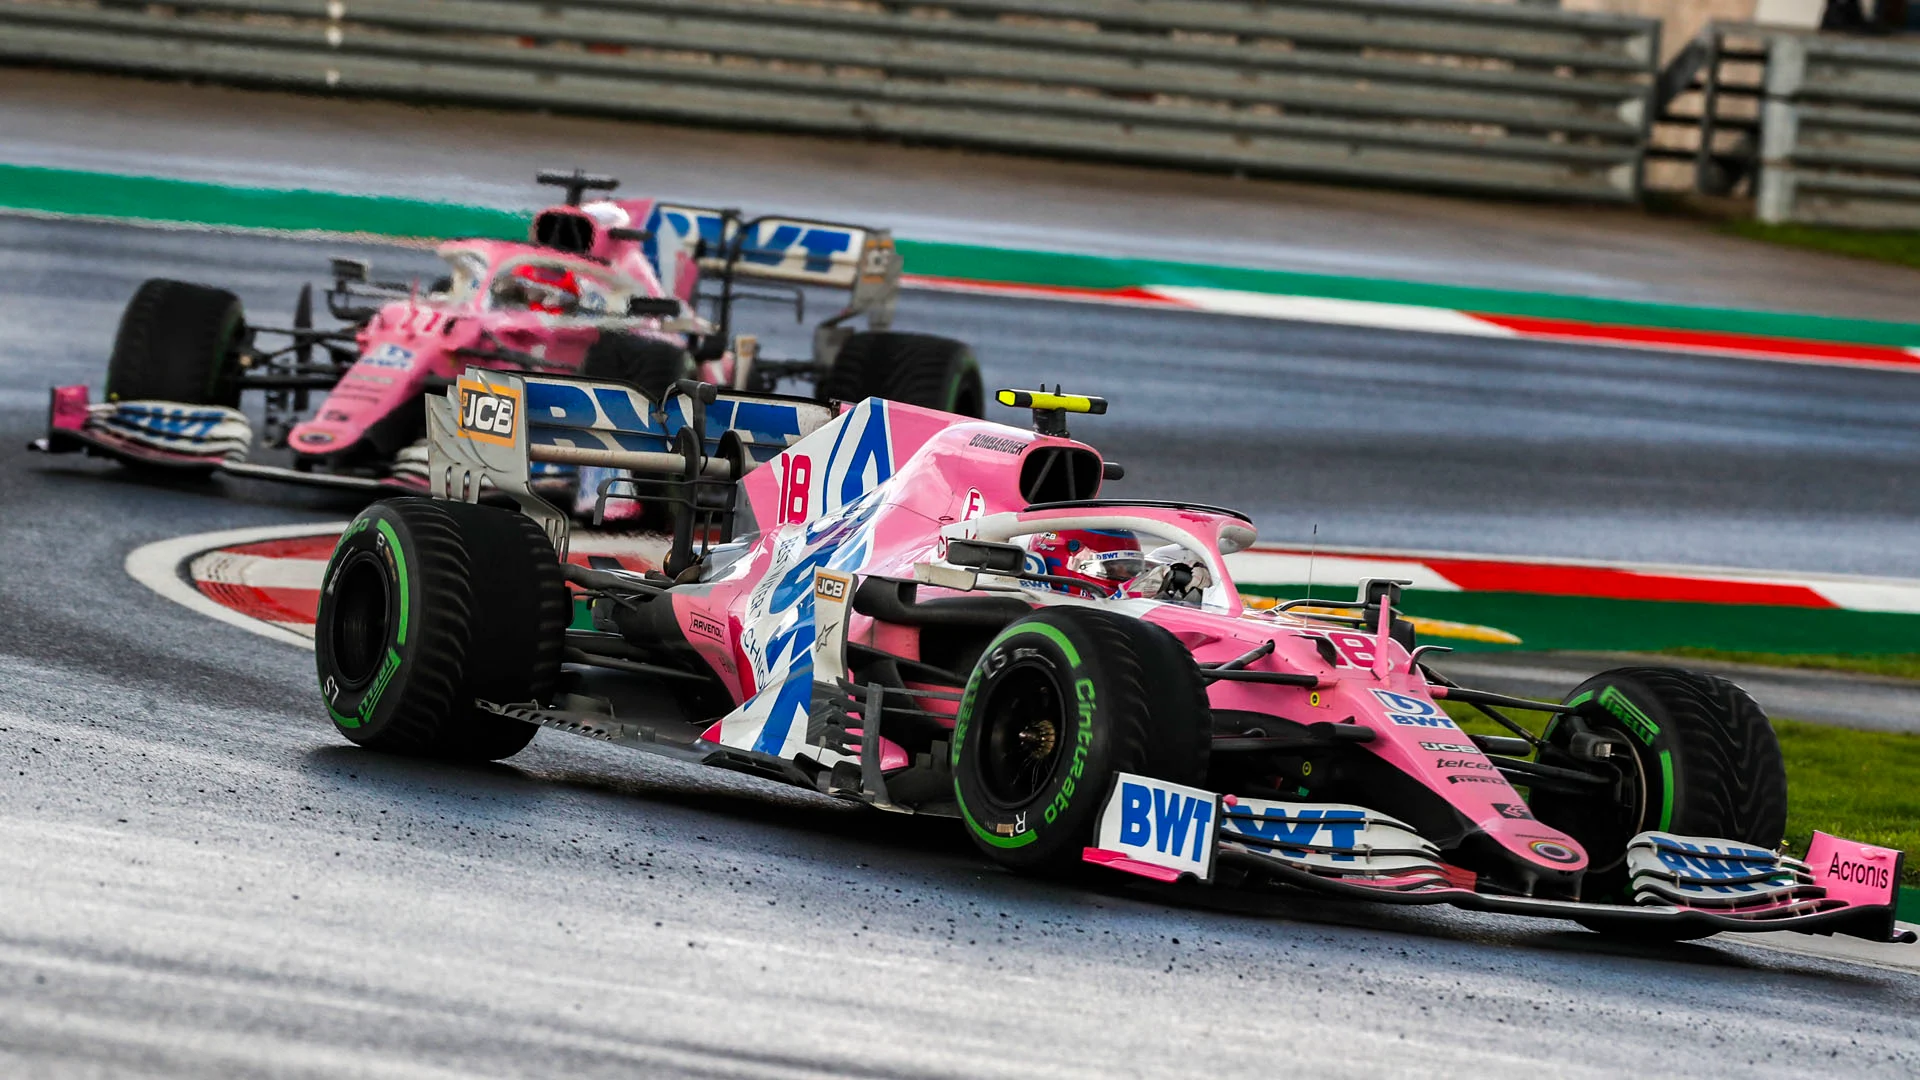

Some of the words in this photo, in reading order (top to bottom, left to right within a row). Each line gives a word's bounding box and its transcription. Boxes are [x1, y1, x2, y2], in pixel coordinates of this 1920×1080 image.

[462, 391, 514, 437] JCB
[968, 433, 1029, 456] BOMBARDIER
[779, 453, 812, 525] 18
[816, 577, 845, 599] JCB
[1390, 714, 1455, 729] BWT
[1043, 677, 1097, 824] Cinturato
[1420, 742, 1481, 754] JCB
[1119, 781, 1213, 863] BWT
[1827, 851, 1890, 890] Acronis
